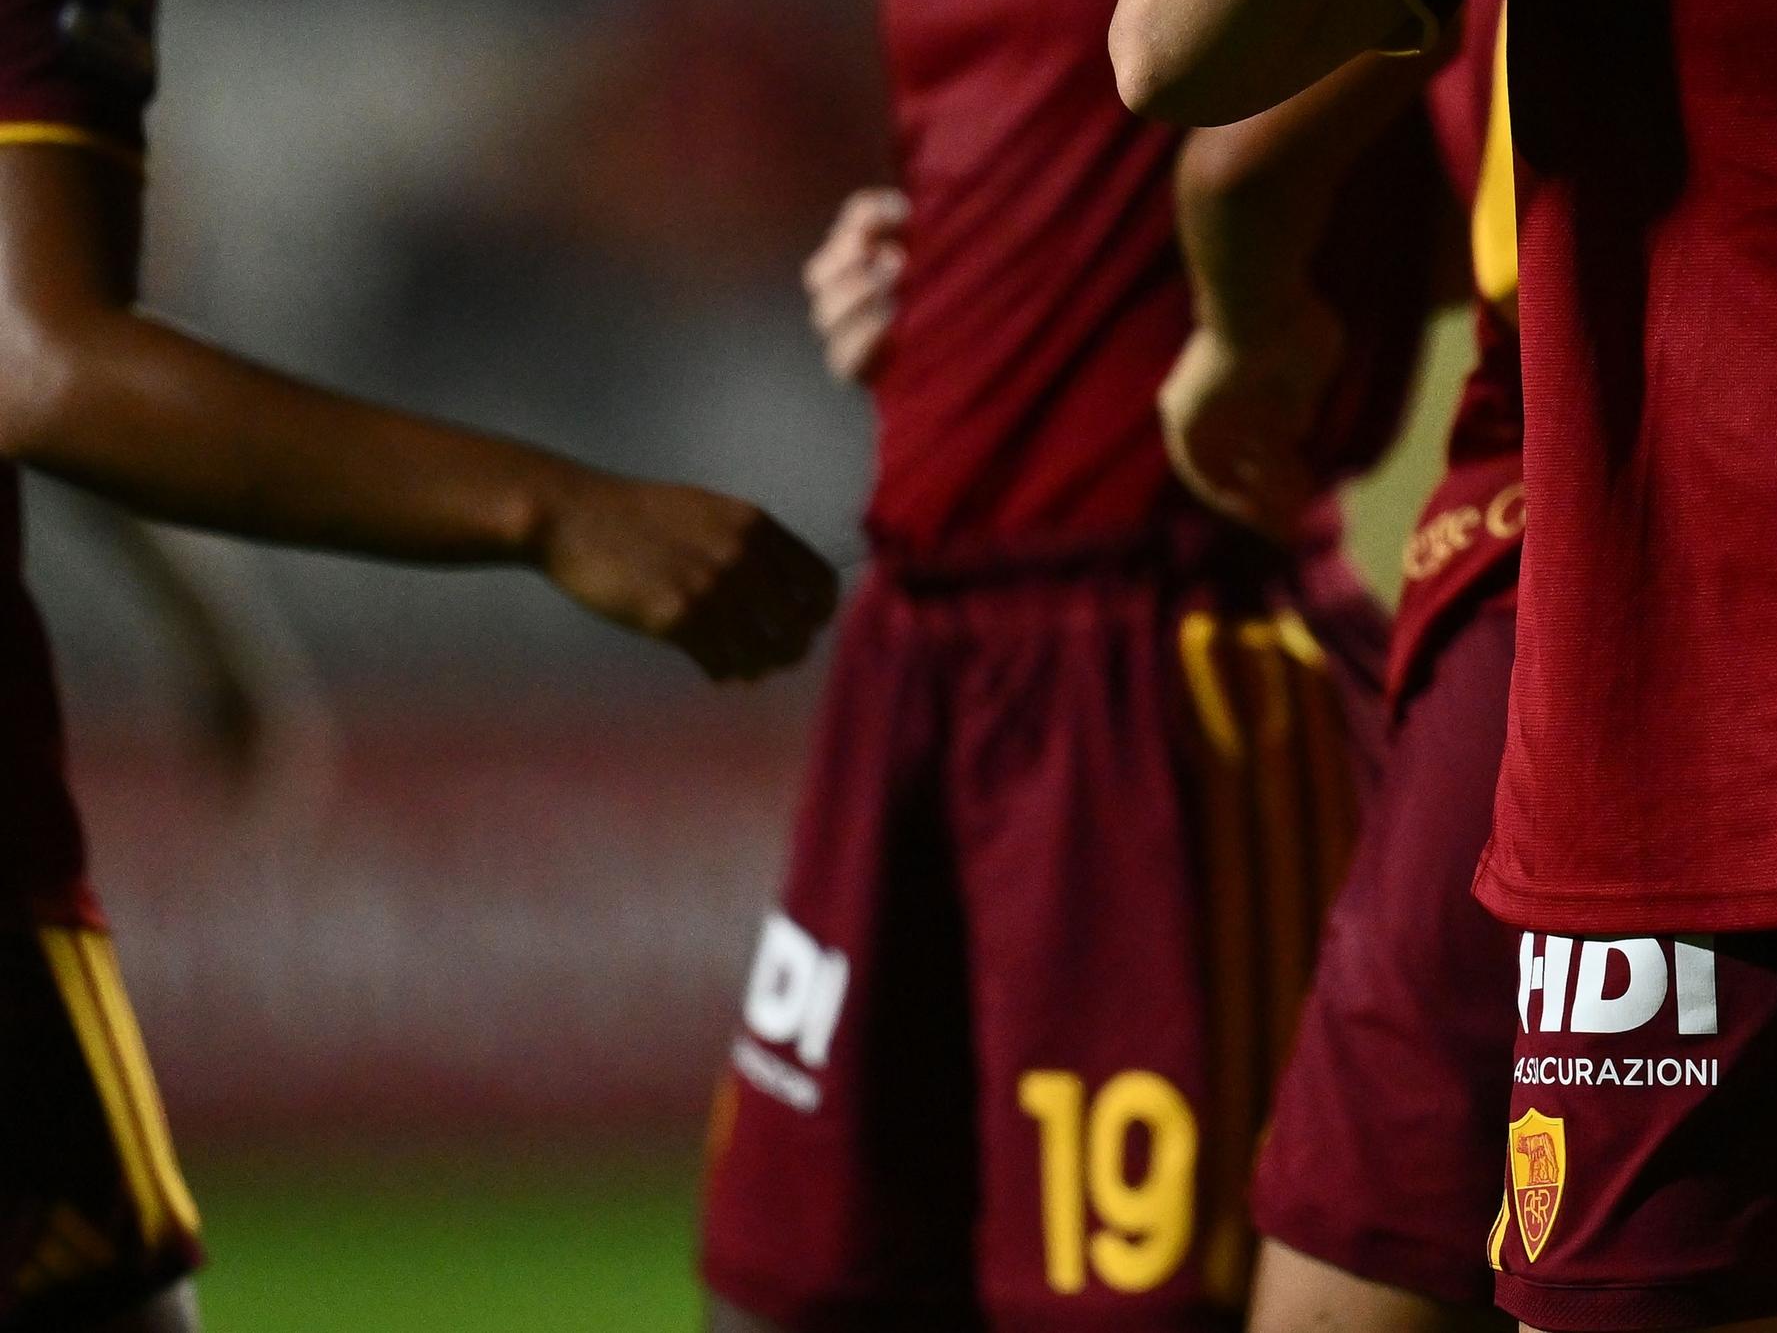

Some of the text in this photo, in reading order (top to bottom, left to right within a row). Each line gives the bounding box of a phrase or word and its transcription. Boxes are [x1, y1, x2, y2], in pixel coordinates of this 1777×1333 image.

[745, 914, 849, 1069] DI
[1518, 931, 1718, 1035] HDI
[1513, 1056, 1718, 1086] ASSICURAZIONI
[1017, 1068, 1197, 1296] 19
